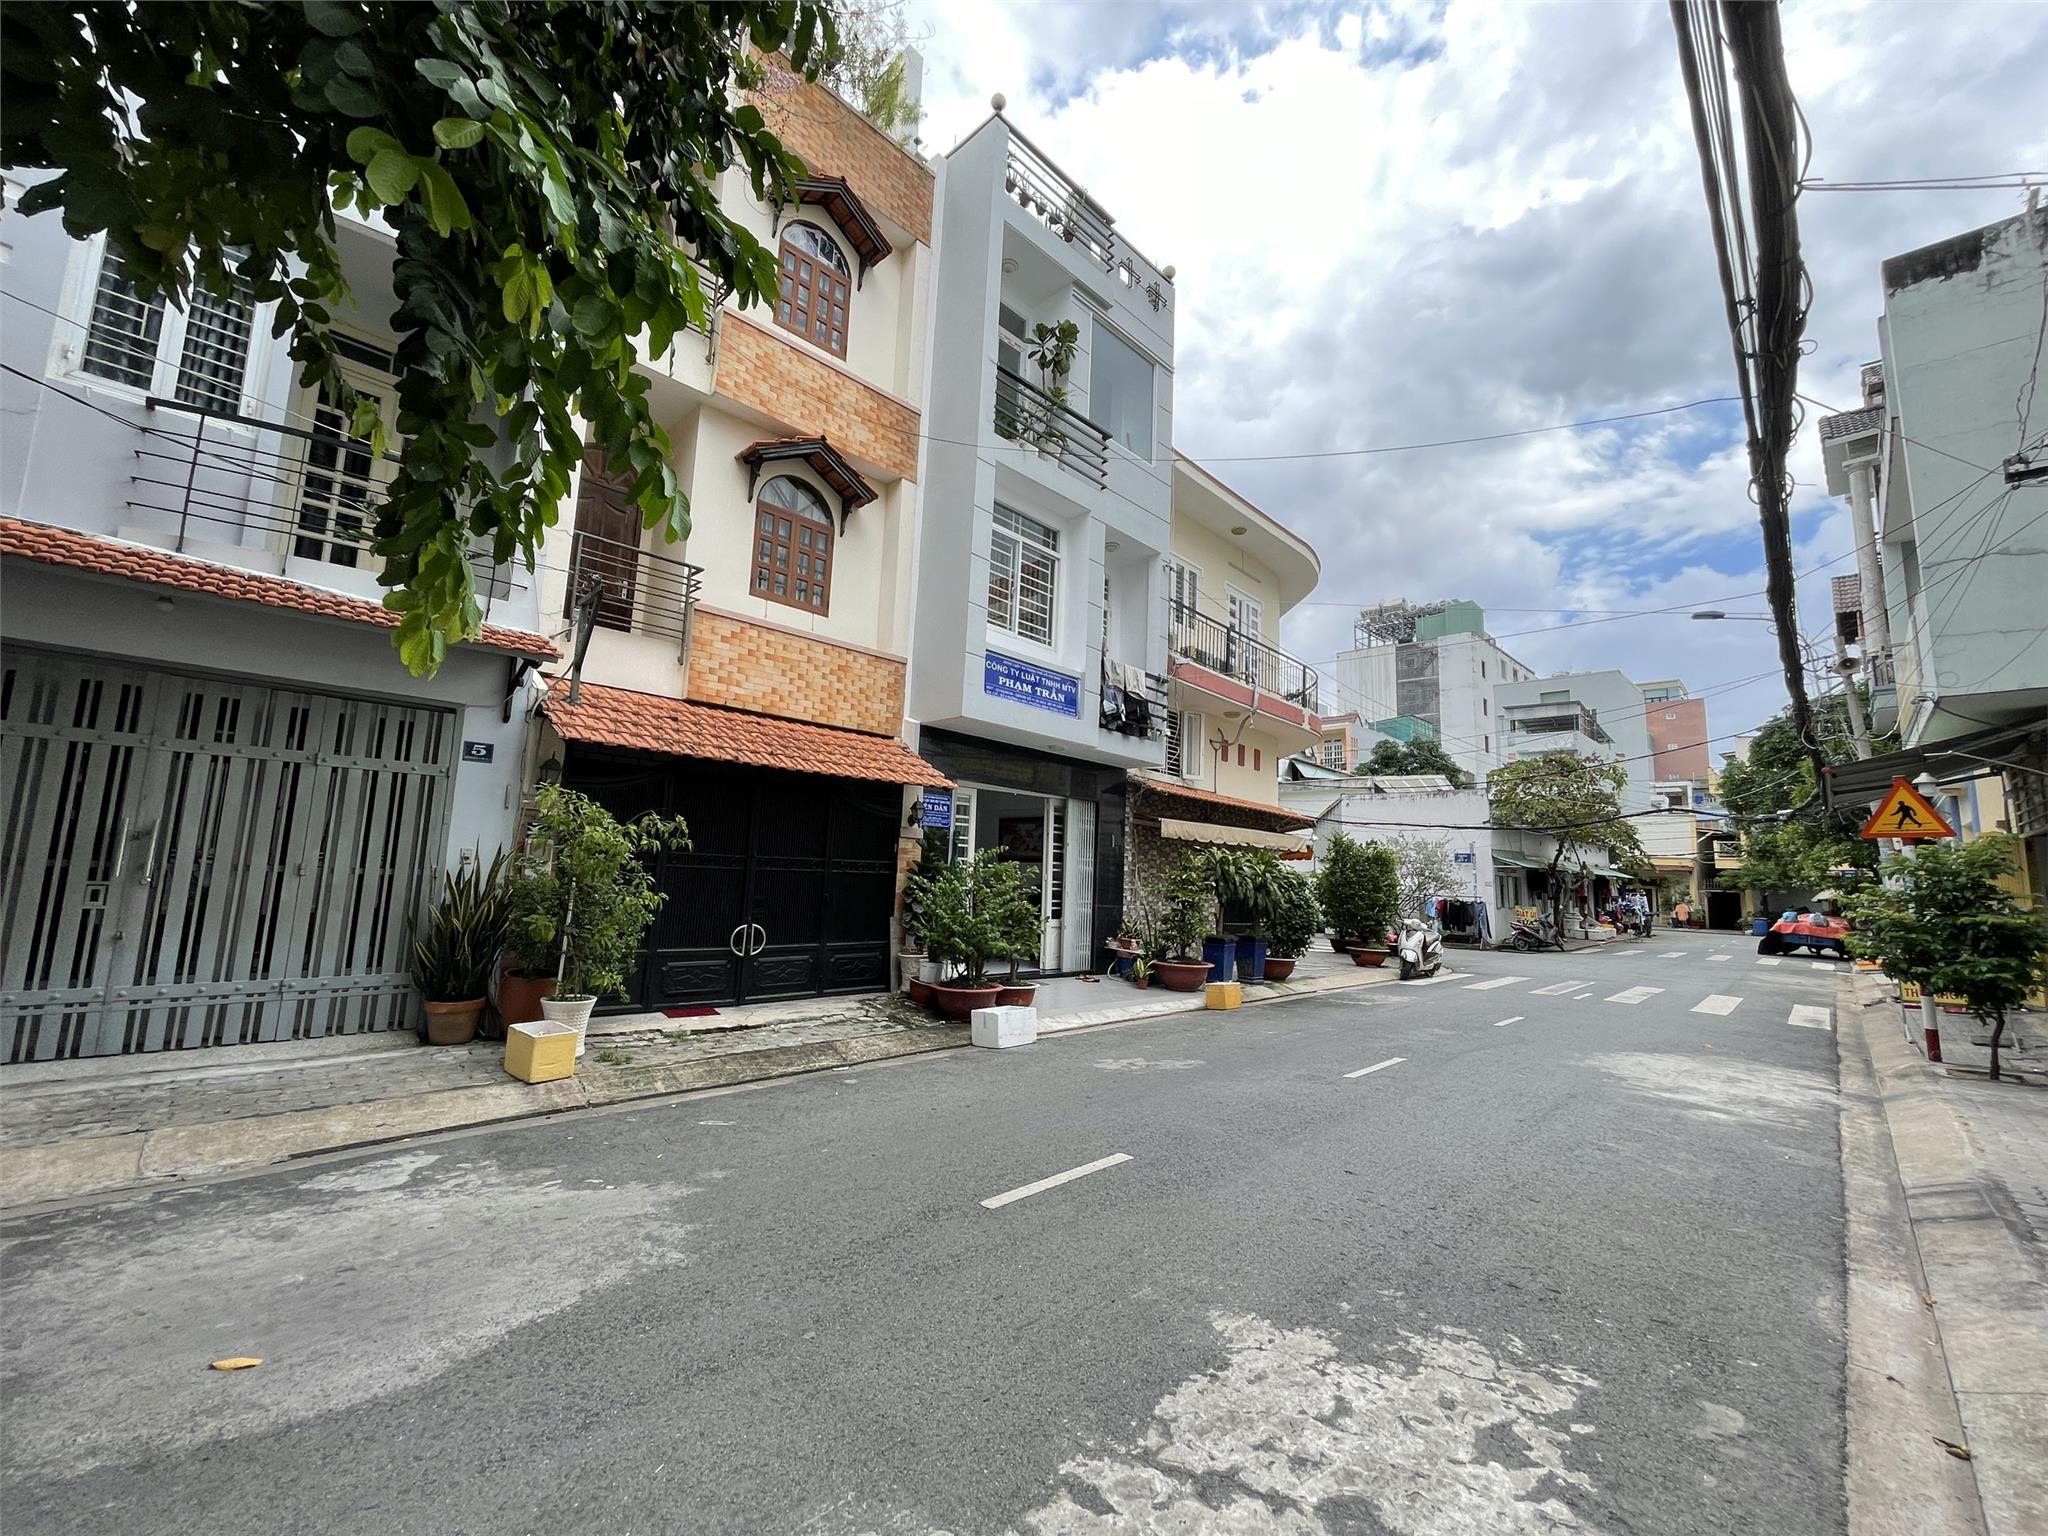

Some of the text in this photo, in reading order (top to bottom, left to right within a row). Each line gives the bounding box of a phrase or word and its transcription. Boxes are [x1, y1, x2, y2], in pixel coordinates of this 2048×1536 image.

[986, 660, 1008, 674] CÔNG
[1010, 668, 1020, 676] TY
[1021, 670, 1040, 683] LUẬT
[1042, 678, 1061, 689] TNHH
[1062, 684, 1077, 694] MTV
[998, 676, 1032, 694] PHẠM
[471, 744, 487, 756] 5
